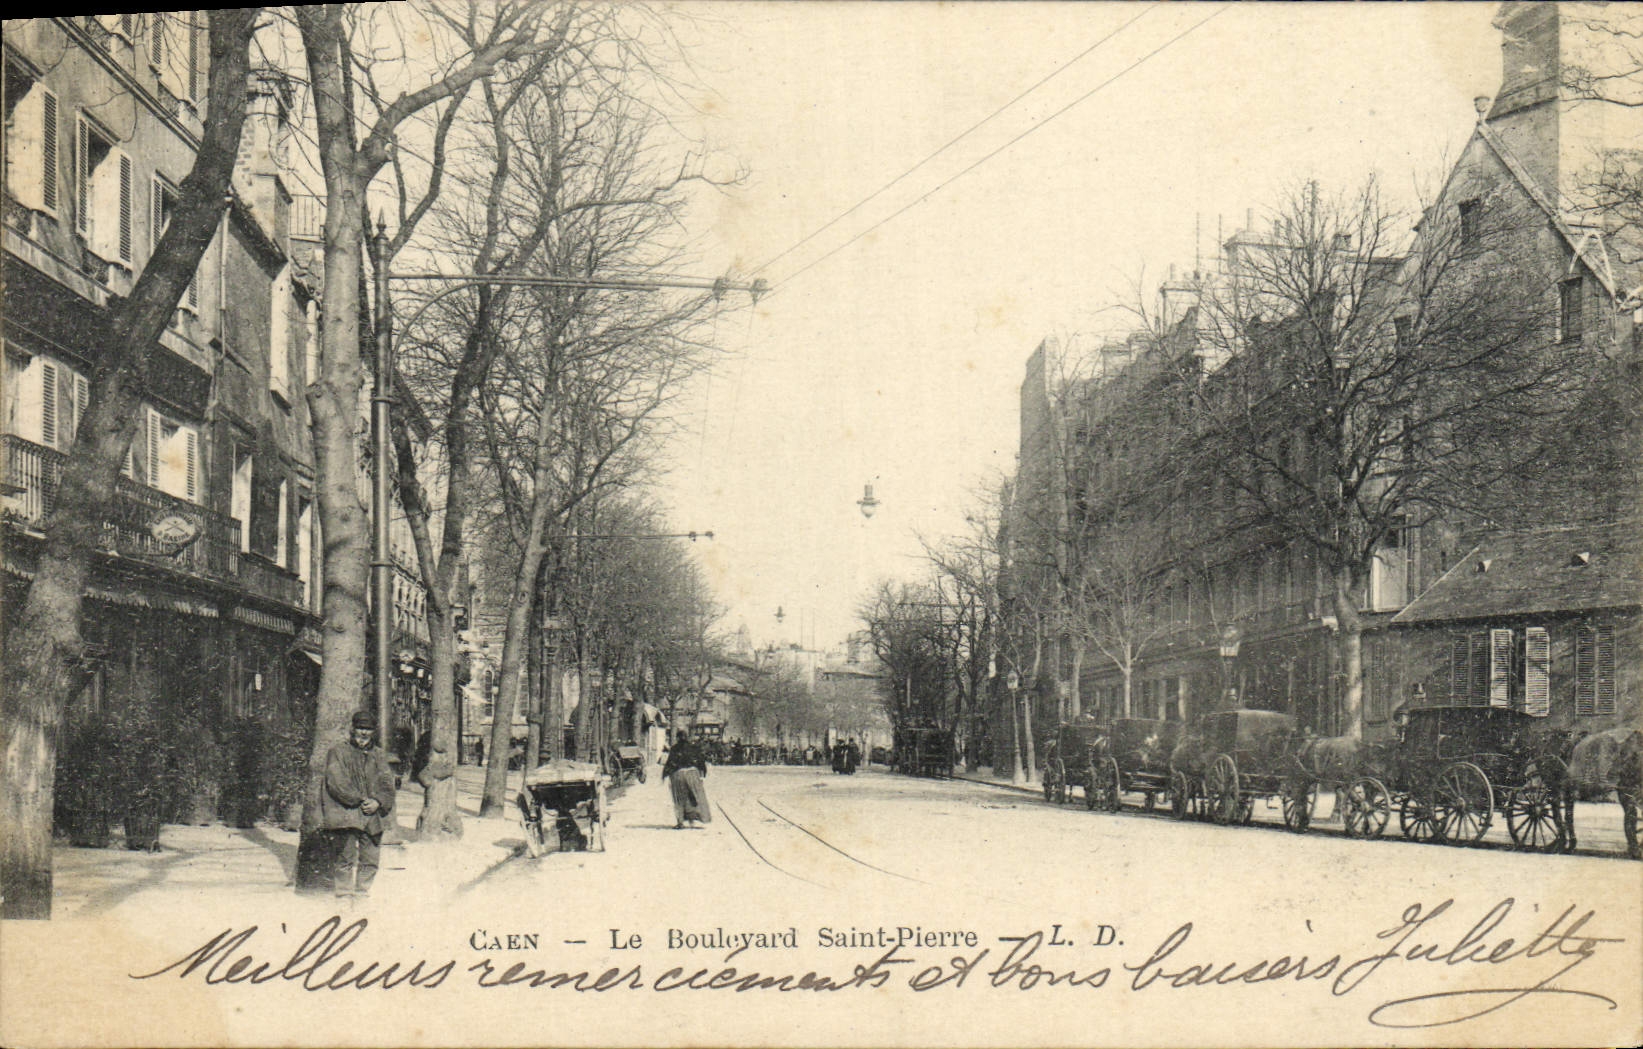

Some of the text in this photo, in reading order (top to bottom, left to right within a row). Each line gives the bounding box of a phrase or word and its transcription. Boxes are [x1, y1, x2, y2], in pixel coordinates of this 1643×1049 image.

[128, 915, 456, 991] Meilleurs
[909, 949, 990, 992] et
[988, 931, 1111, 990] bons
[1123, 921, 1342, 991] baisers
[1332, 897, 1625, 1028] Juliette
